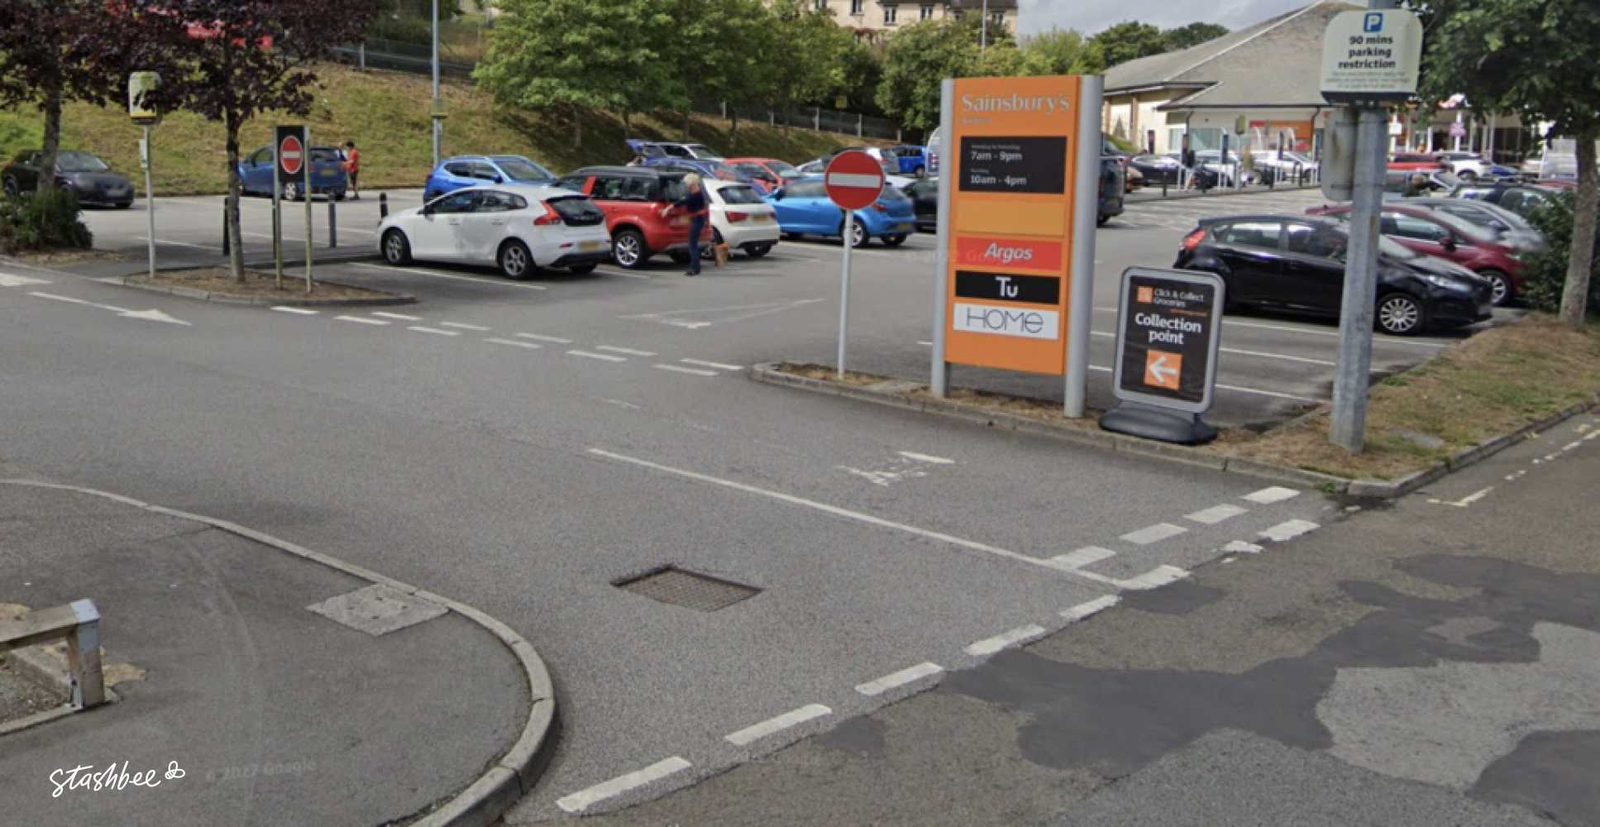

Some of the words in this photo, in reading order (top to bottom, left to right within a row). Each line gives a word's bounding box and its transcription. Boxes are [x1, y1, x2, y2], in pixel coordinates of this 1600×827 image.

[1349, 36, 1364, 45] 90
[1366, 35, 1393, 44] mins
[1348, 47, 1392, 58] parking
[1338, 59, 1396, 68] restriction
[961, 93, 1070, 117] Sainsbury's
[971, 151, 992, 161] 7am
[999, 151, 1023, 163] 9pm
[970, 175, 996, 184] 10am
[1004, 175, 1027, 187] 4pm
[984, 243, 1033, 263] Argos
[995, 276, 1018, 298] Tu
[1135, 312, 1202, 334] Collection
[1148, 329, 1185, 345] point
